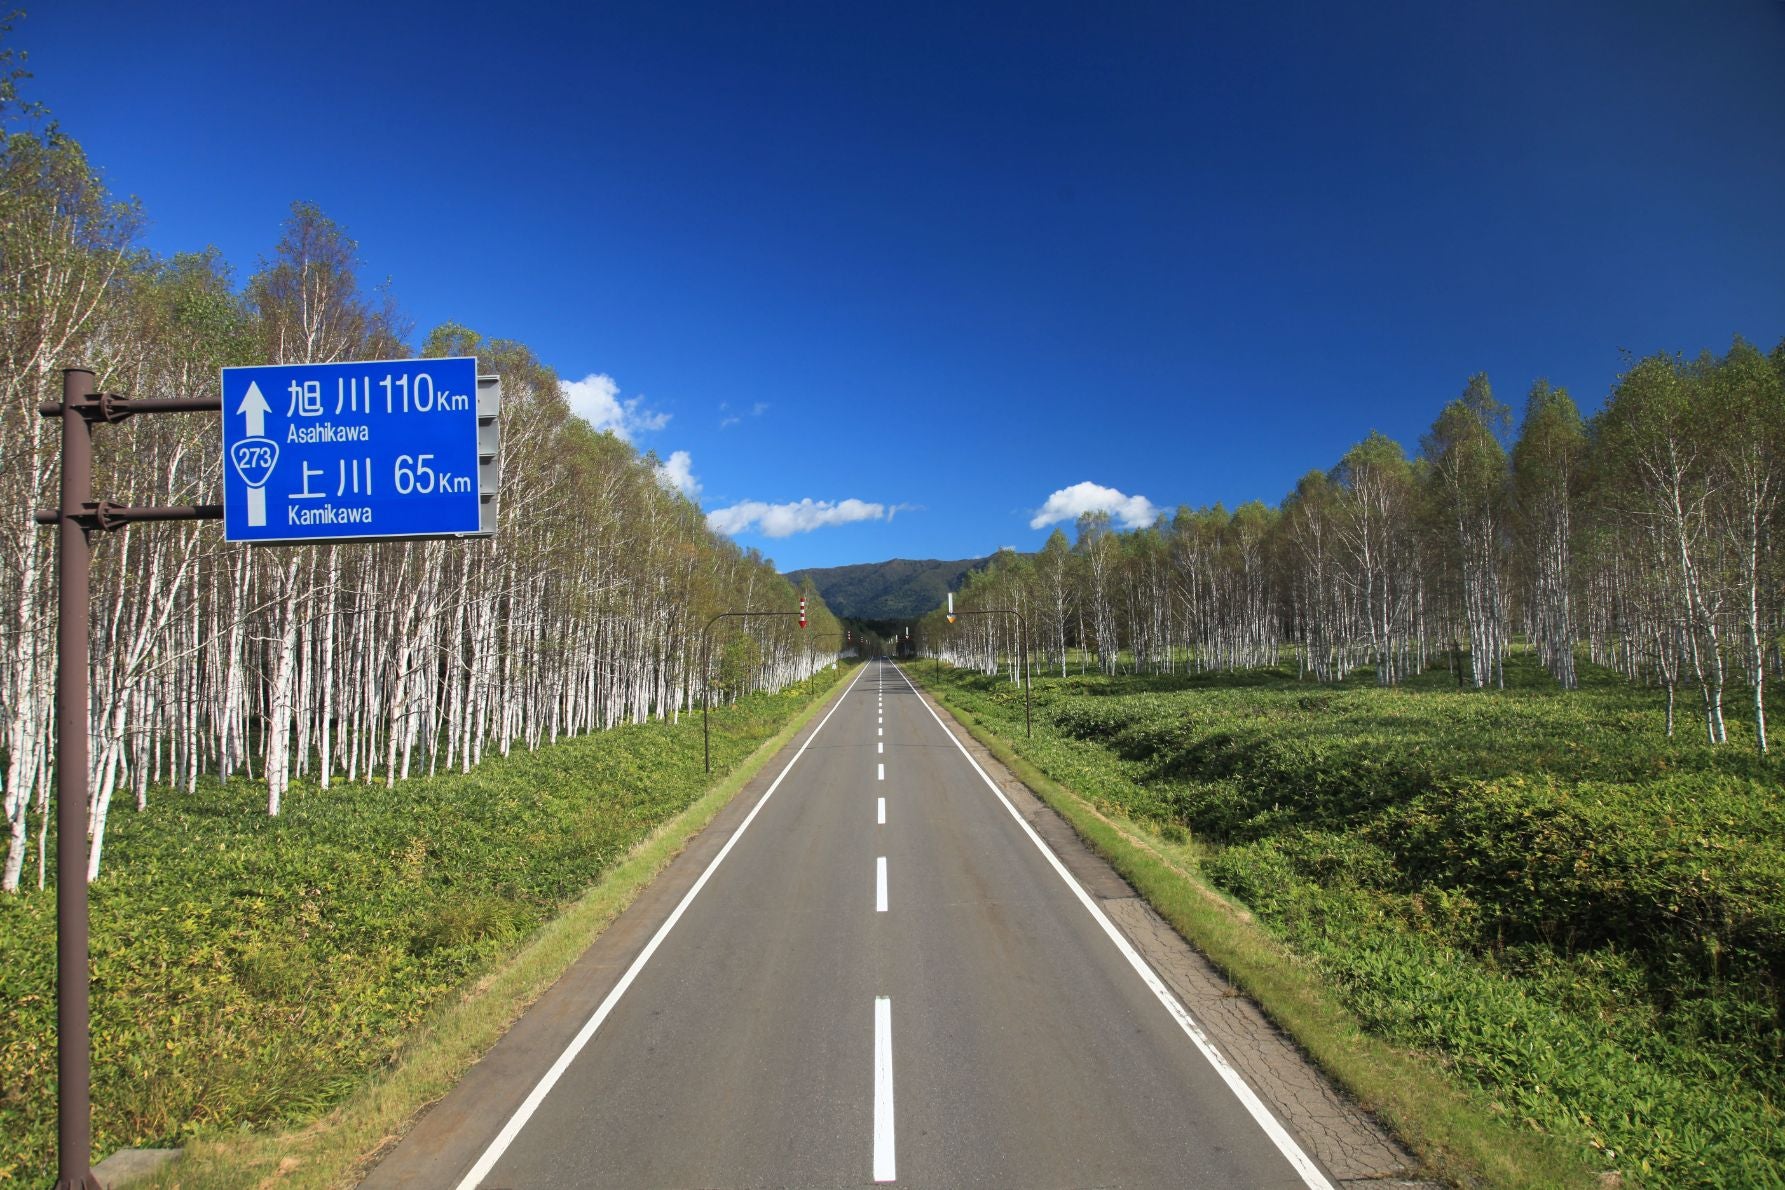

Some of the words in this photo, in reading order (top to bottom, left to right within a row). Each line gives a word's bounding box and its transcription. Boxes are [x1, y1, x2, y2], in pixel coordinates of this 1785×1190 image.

[287, 376, 370, 417] 旭川
[287, 422, 369, 443] Asahikawa
[238, 447, 272, 468] 273
[288, 457, 372, 499] 上川
[288, 504, 372, 525] Kamikawa
